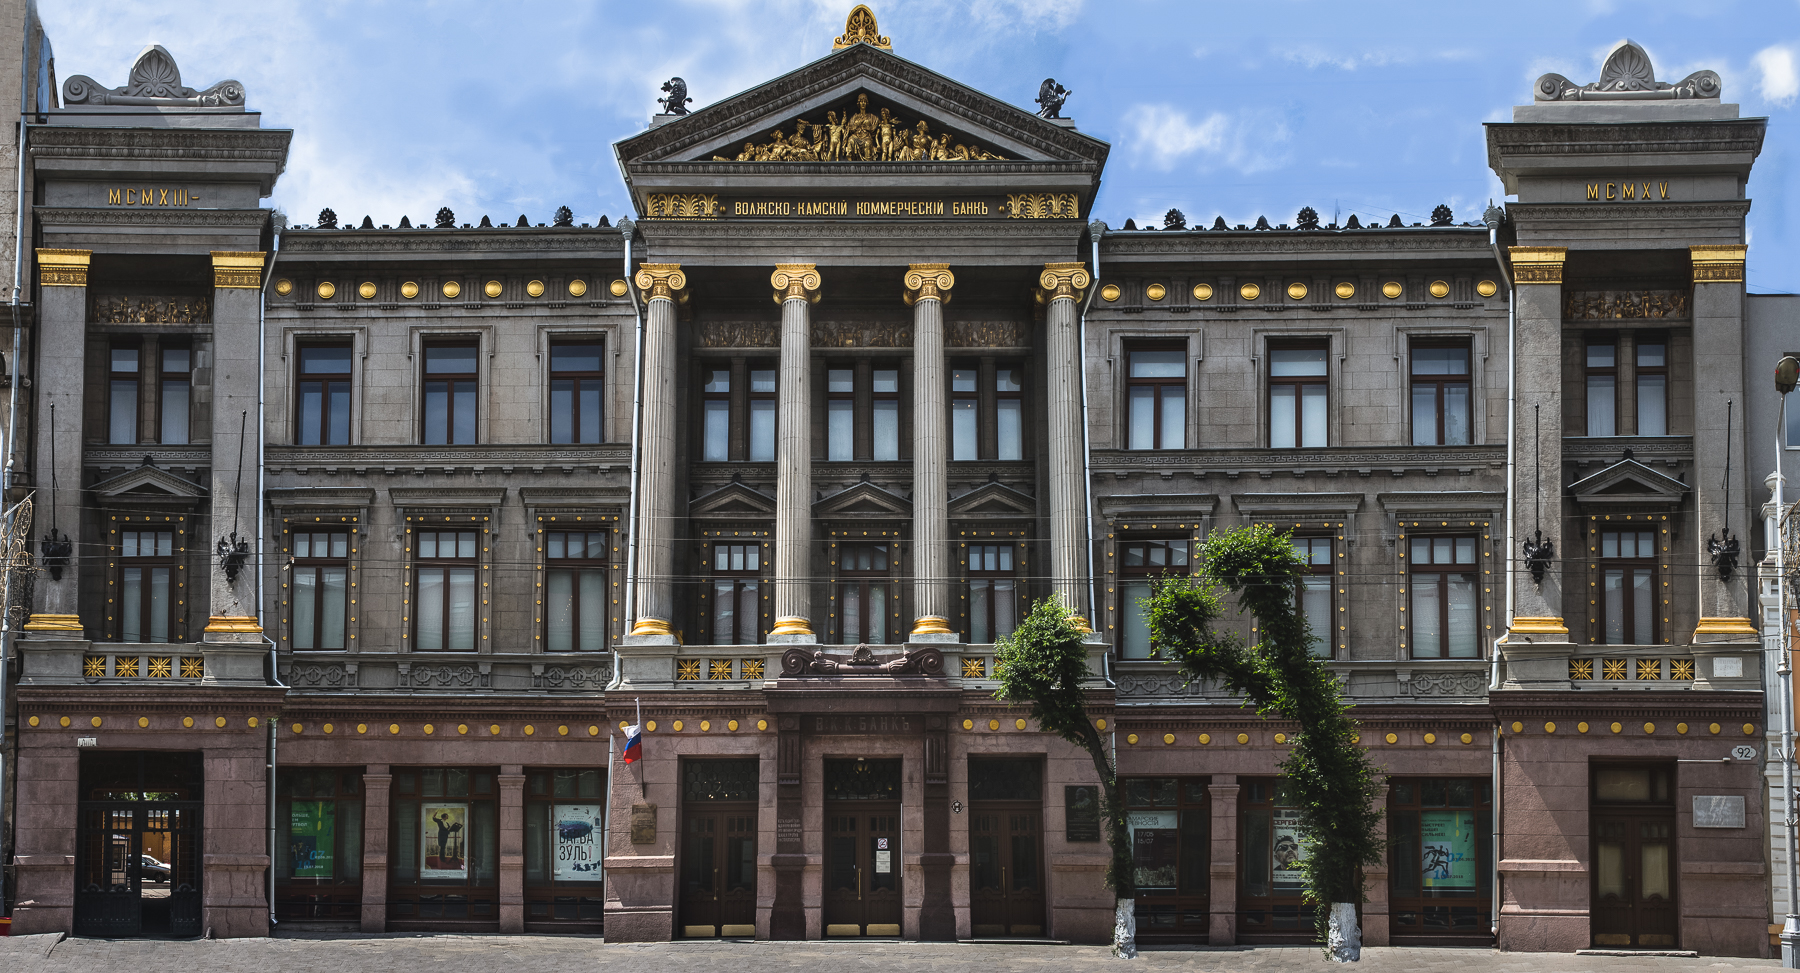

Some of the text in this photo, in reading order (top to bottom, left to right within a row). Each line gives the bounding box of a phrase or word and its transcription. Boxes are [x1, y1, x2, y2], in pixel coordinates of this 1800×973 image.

[856, 200, 944, 215] КОММЕРЧЕСКІЙ
[953, 202, 989, 215] БАНКЪ
[1737, 747, 1751, 758] 92
[1446, 852, 1464, 862] 07
